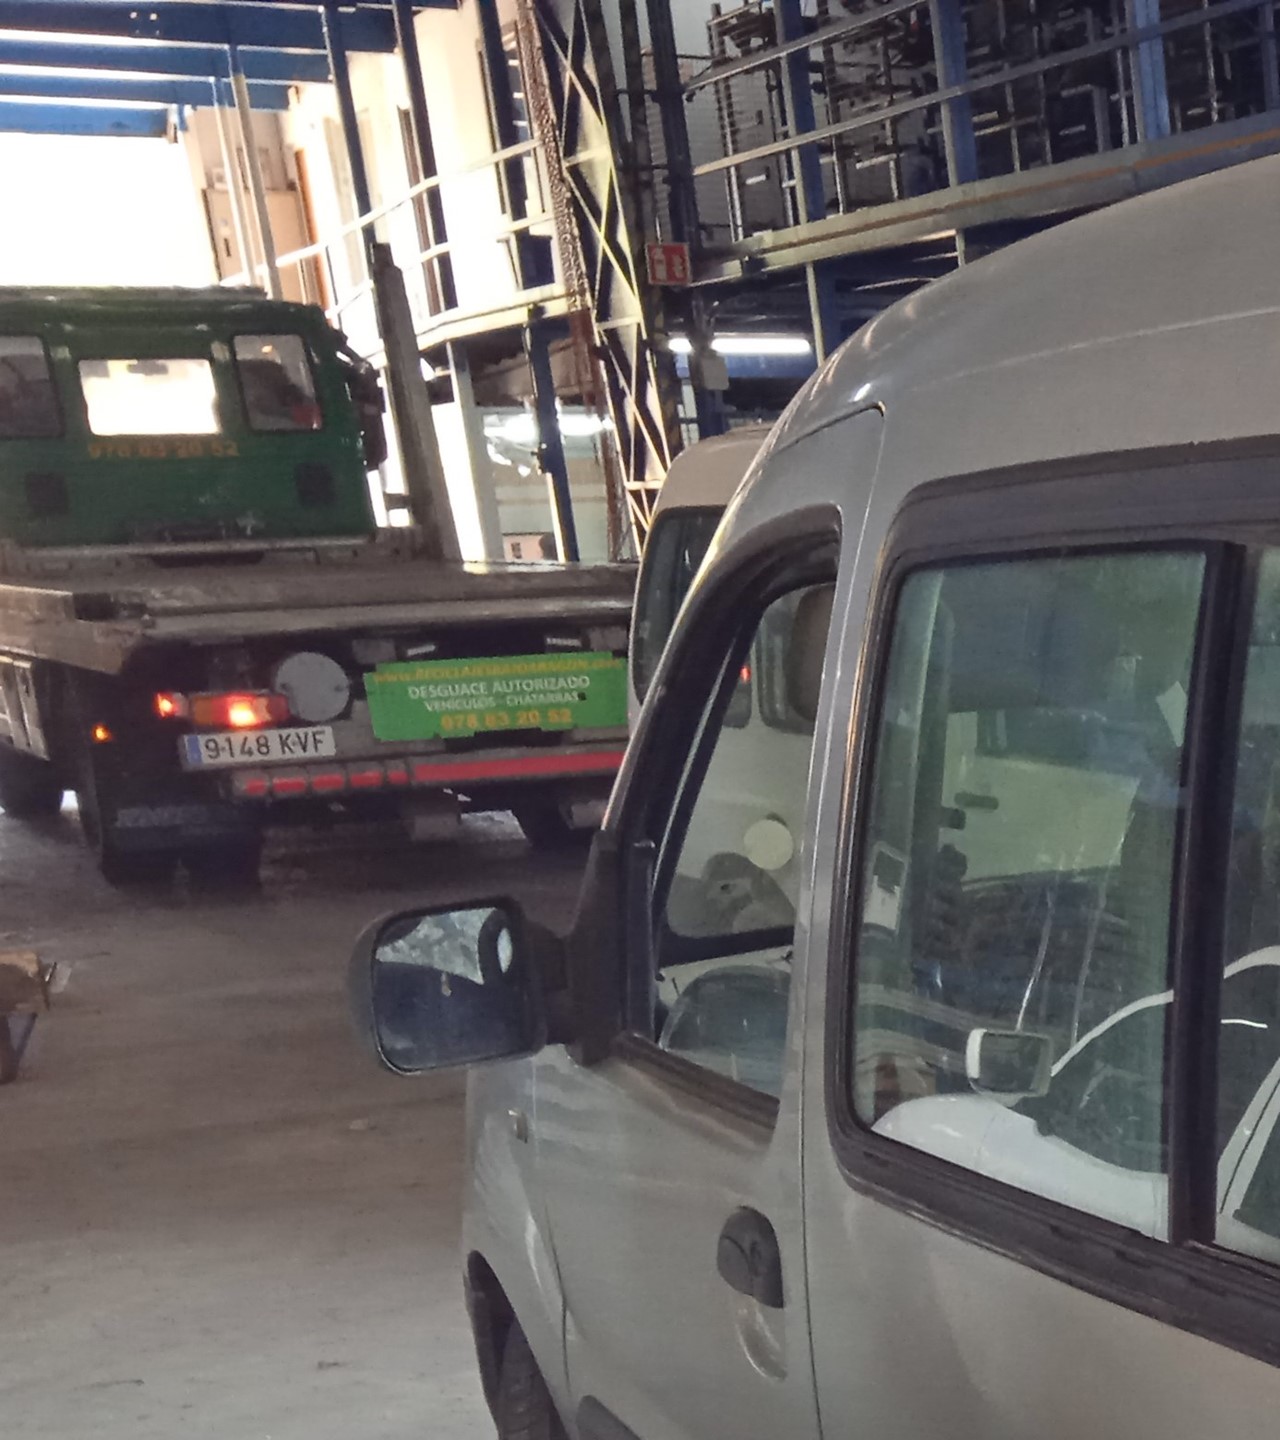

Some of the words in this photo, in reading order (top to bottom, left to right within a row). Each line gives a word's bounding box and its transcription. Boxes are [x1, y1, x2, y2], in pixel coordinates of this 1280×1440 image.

[408, 681, 488, 699] DESGUACE
[493, 675, 590, 693] AUTORIZADO
[441, 713, 479, 731] 978
[517, 709, 541, 726] 20
[548, 708, 573, 724] 52
[205, 735, 271, 760] 9148
[279, 730, 326, 755] KVF
